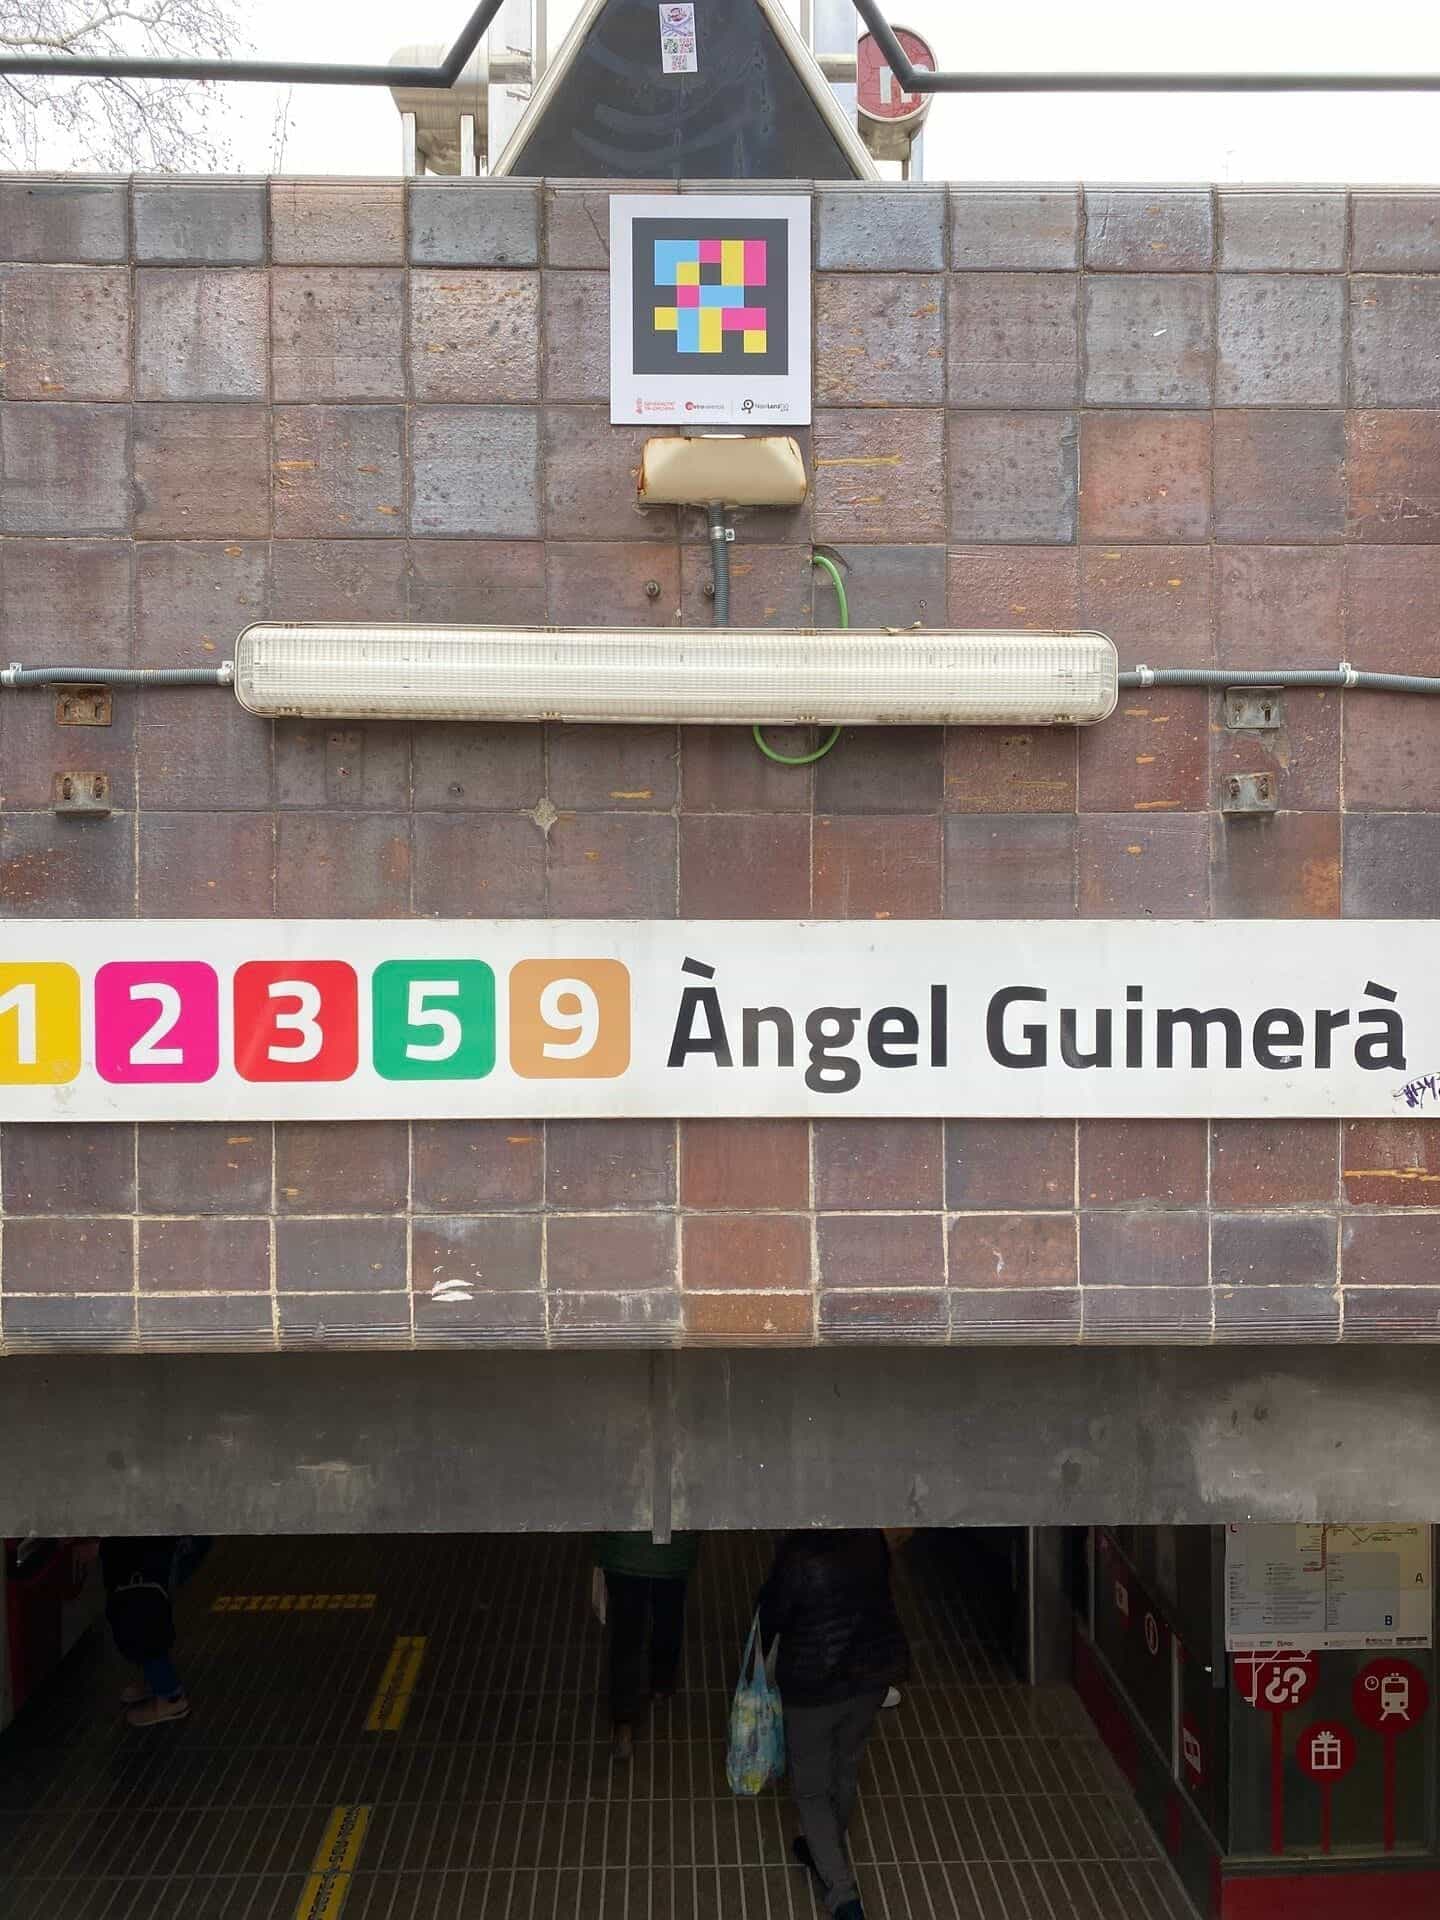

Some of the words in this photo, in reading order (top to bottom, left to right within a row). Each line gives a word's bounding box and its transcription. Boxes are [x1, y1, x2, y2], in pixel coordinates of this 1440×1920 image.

[0, 984, 38, 1065] 1
[128, 983, 184, 1065] 2
[267, 980, 324, 1063] 3
[405, 980, 462, 1062] 5
[538, 978, 600, 1060] 9
[667, 956, 948, 1094] Àngel
[985, 980, 1407, 1071] Guimerà
[1415, 1572, 1424, 1584] A
[1384, 1615, 1393, 1626] B
